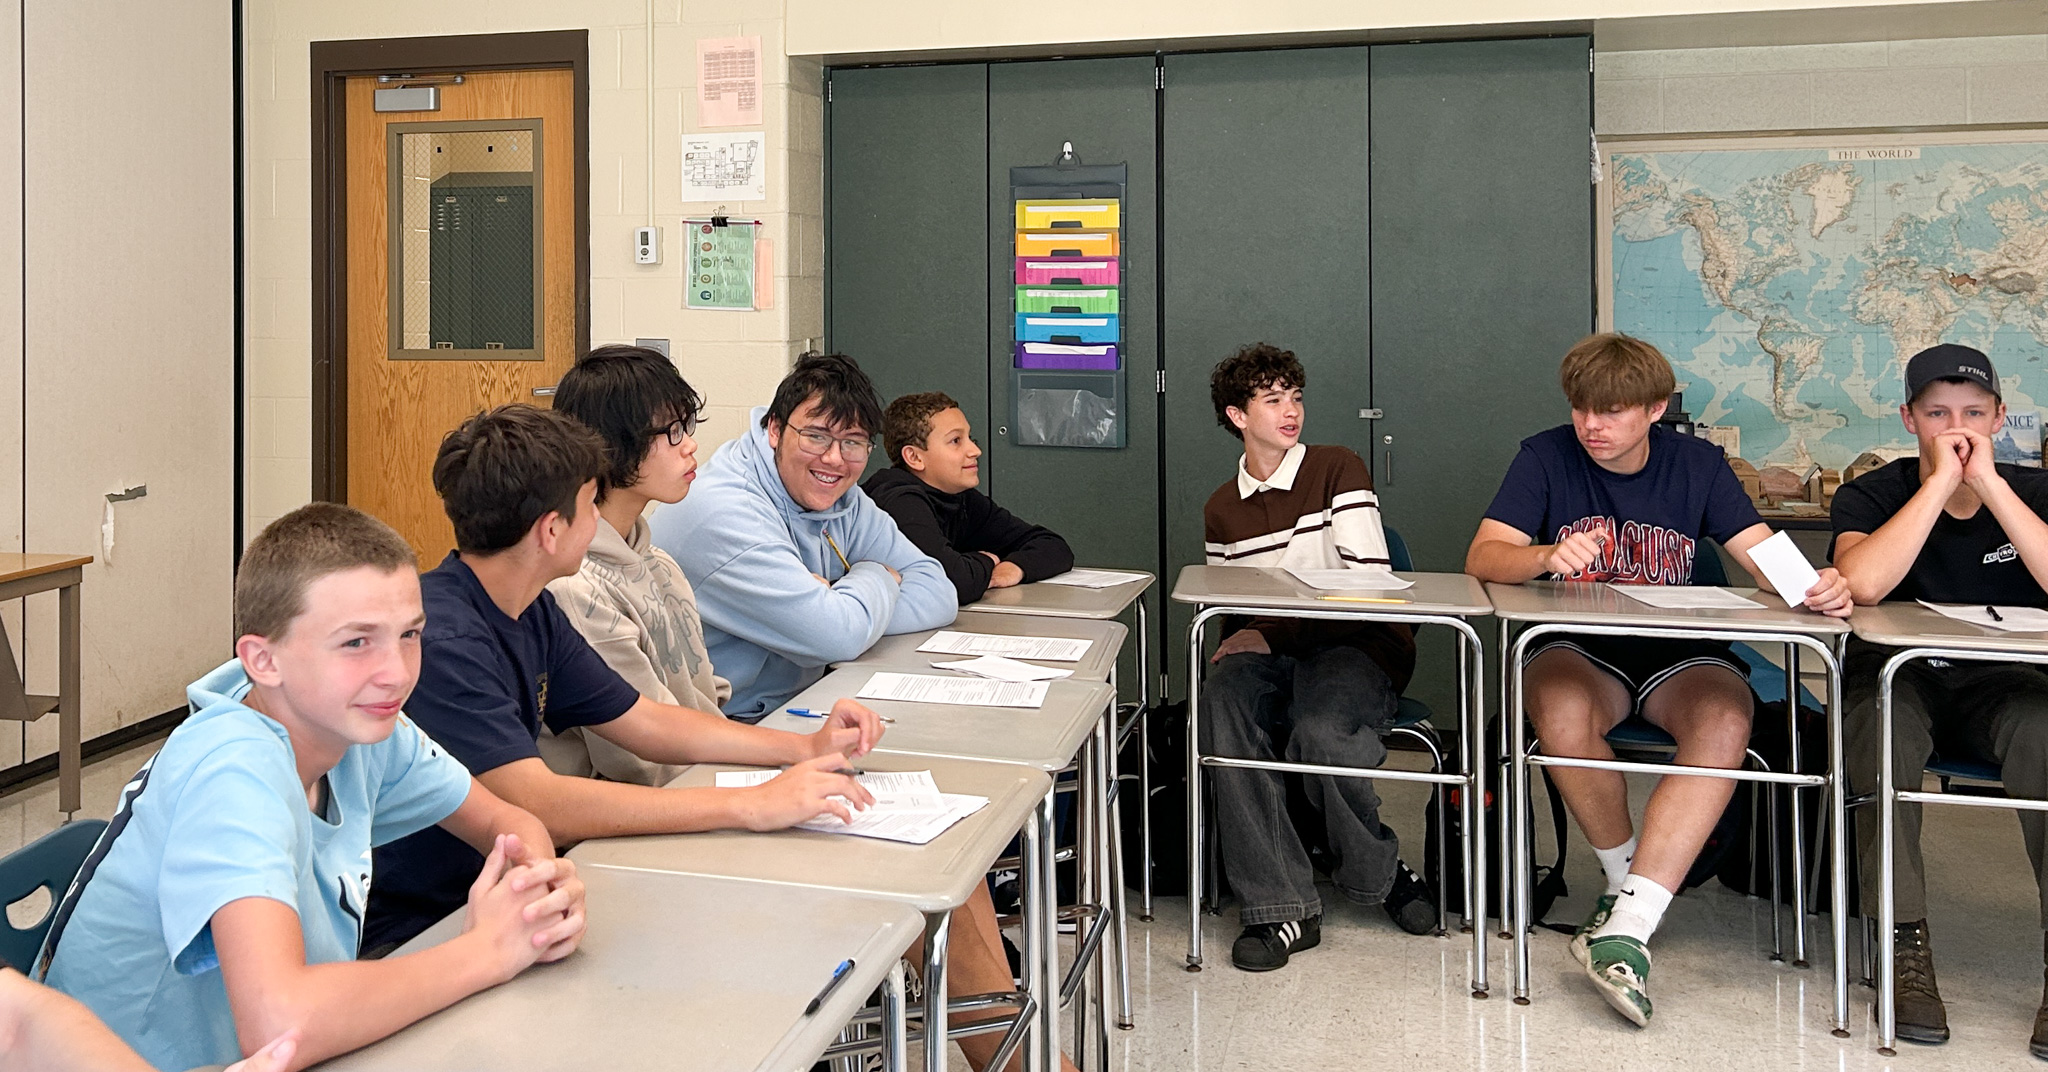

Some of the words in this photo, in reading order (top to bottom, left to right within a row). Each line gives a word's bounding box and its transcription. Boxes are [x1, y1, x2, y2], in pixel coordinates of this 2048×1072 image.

[1837, 150, 1860, 160] THE
[1866, 149, 1913, 159] WORLD
[1958, 365, 1989, 381] STIHL
[2003, 415, 2034, 427] NICE
